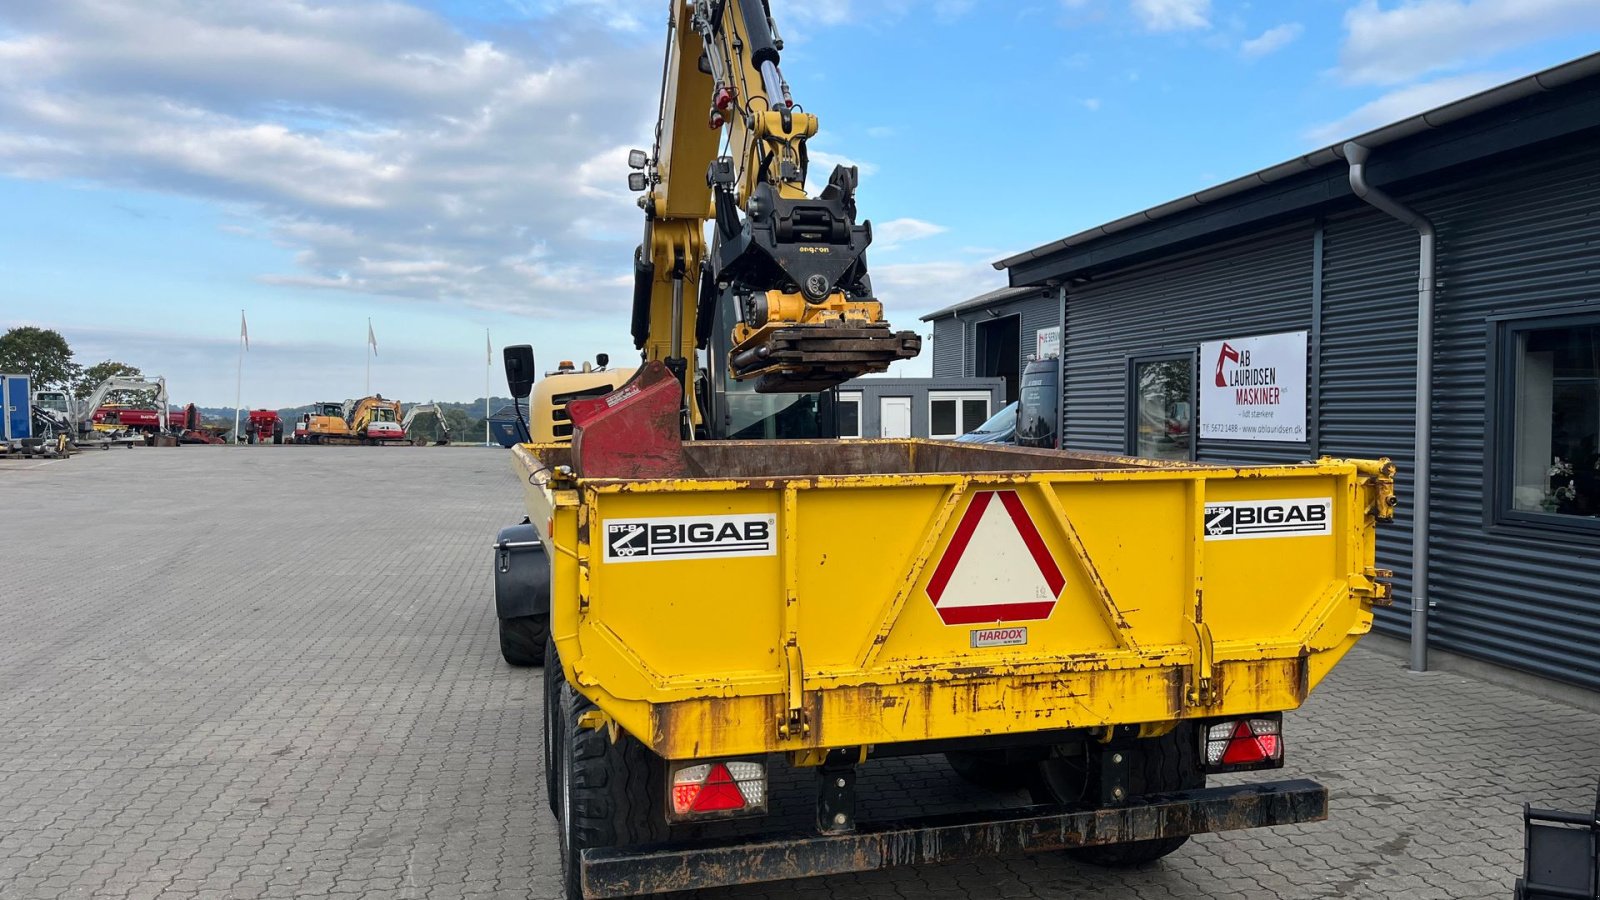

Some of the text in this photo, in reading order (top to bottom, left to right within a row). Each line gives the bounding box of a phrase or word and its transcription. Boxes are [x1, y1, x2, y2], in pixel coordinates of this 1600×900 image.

[1240, 350, 1251, 367] AB
[1230, 367, 1276, 386] LAURIDSEN
[1236, 387, 1280, 405] MASKINER
[1242, 424, 1303, 434] www.ablauridsen.dk
[1235, 504, 1326, 525] BIGAB
[650, 521, 769, 545] BIGAB
[978, 629, 1023, 641] HARDOX
